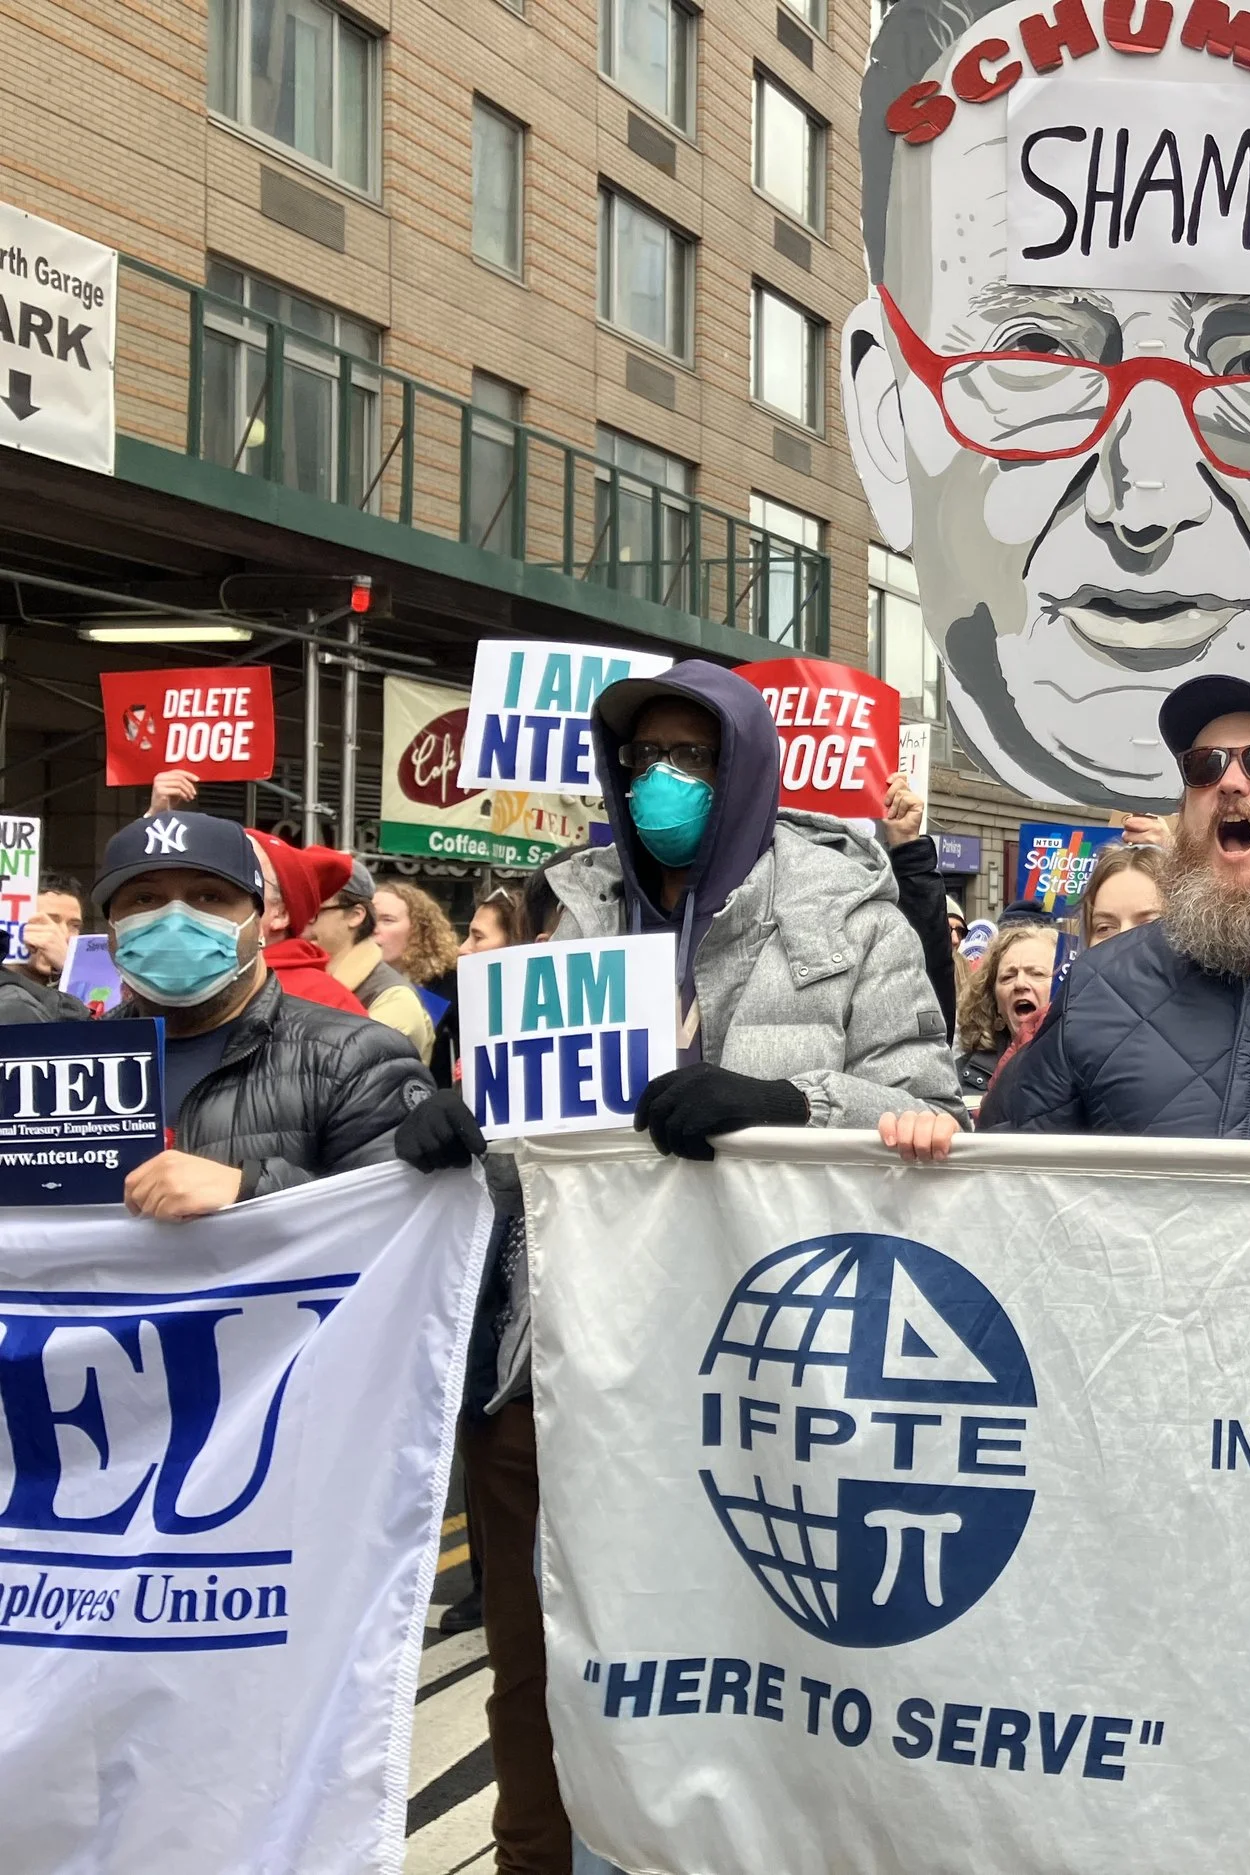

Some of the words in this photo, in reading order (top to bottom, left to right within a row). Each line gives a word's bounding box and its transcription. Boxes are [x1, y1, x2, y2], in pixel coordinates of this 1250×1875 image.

[35, 256, 104, 310] Garage
[163, 687, 251, 719] DELETE
[504, 652, 524, 709] I
[165, 721, 254, 763] DOGE
[477, 714, 594, 785] NTE
[144, 817, 188, 854] NY
[429, 831, 489, 857] Coffee.
[1024, 851, 1098, 872] Solidari
[1036, 839, 1060, 847] NTEU
[488, 962, 502, 1037] I
[520, 949, 626, 1033] AM
[0, 1056, 152, 1118] TEU
[474, 1028, 649, 1128] NTEU
[18, 1124, 61, 1137] Treasury
[63, 1121, 119, 1136] Employees
[122, 1119, 156, 1131] Union
[702, 1392, 1027, 1476] IFPTE
[0, 1572, 119, 1630] ployees
[134, 1574, 288, 1623] Union
[583, 1656, 785, 1722] "HERE
[799, 1675, 873, 1748] TO
[892, 1697, 1165, 1782] SERVE"
